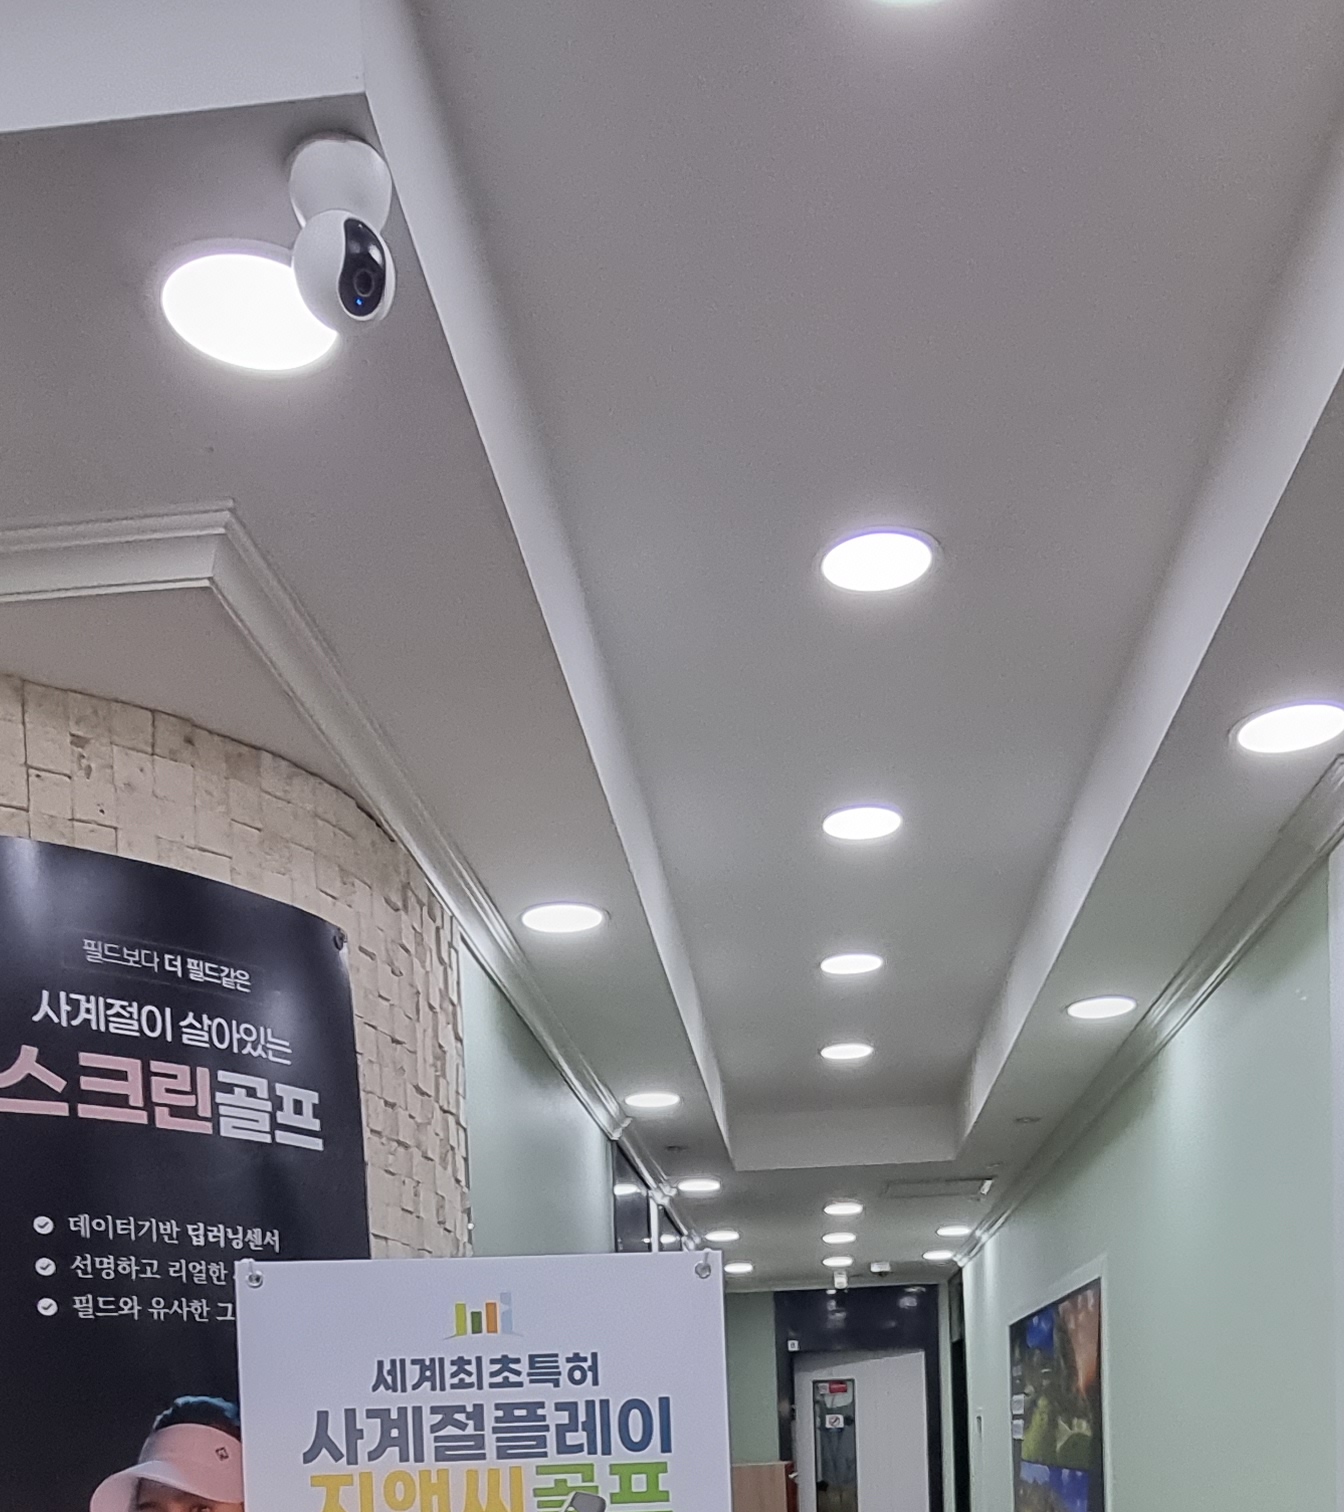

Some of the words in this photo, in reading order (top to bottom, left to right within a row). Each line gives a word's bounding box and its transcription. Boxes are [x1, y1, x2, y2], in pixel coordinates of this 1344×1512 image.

[83, 938, 159, 973] 필드보다
[164, 953, 182, 978] 더
[186, 957, 252, 993] 필드같은
[32, 988, 173, 1043] 사계절이
[179, 1011, 293, 1066] 살아있는
[68, 1213, 180, 1244] 데이터기반
[186, 1222, 280, 1253] 딥러닝센서
[70, 1254, 161, 1280] 선명하고
[168, 1259, 229, 1285] 리얼한
[72, 1294, 141, 1320] 필드와
[147, 1298, 211, 1321] 유사한
[371, 1351, 600, 1394] 세계최초특허
[302, 1395, 673, 1466] 사계절플레이
